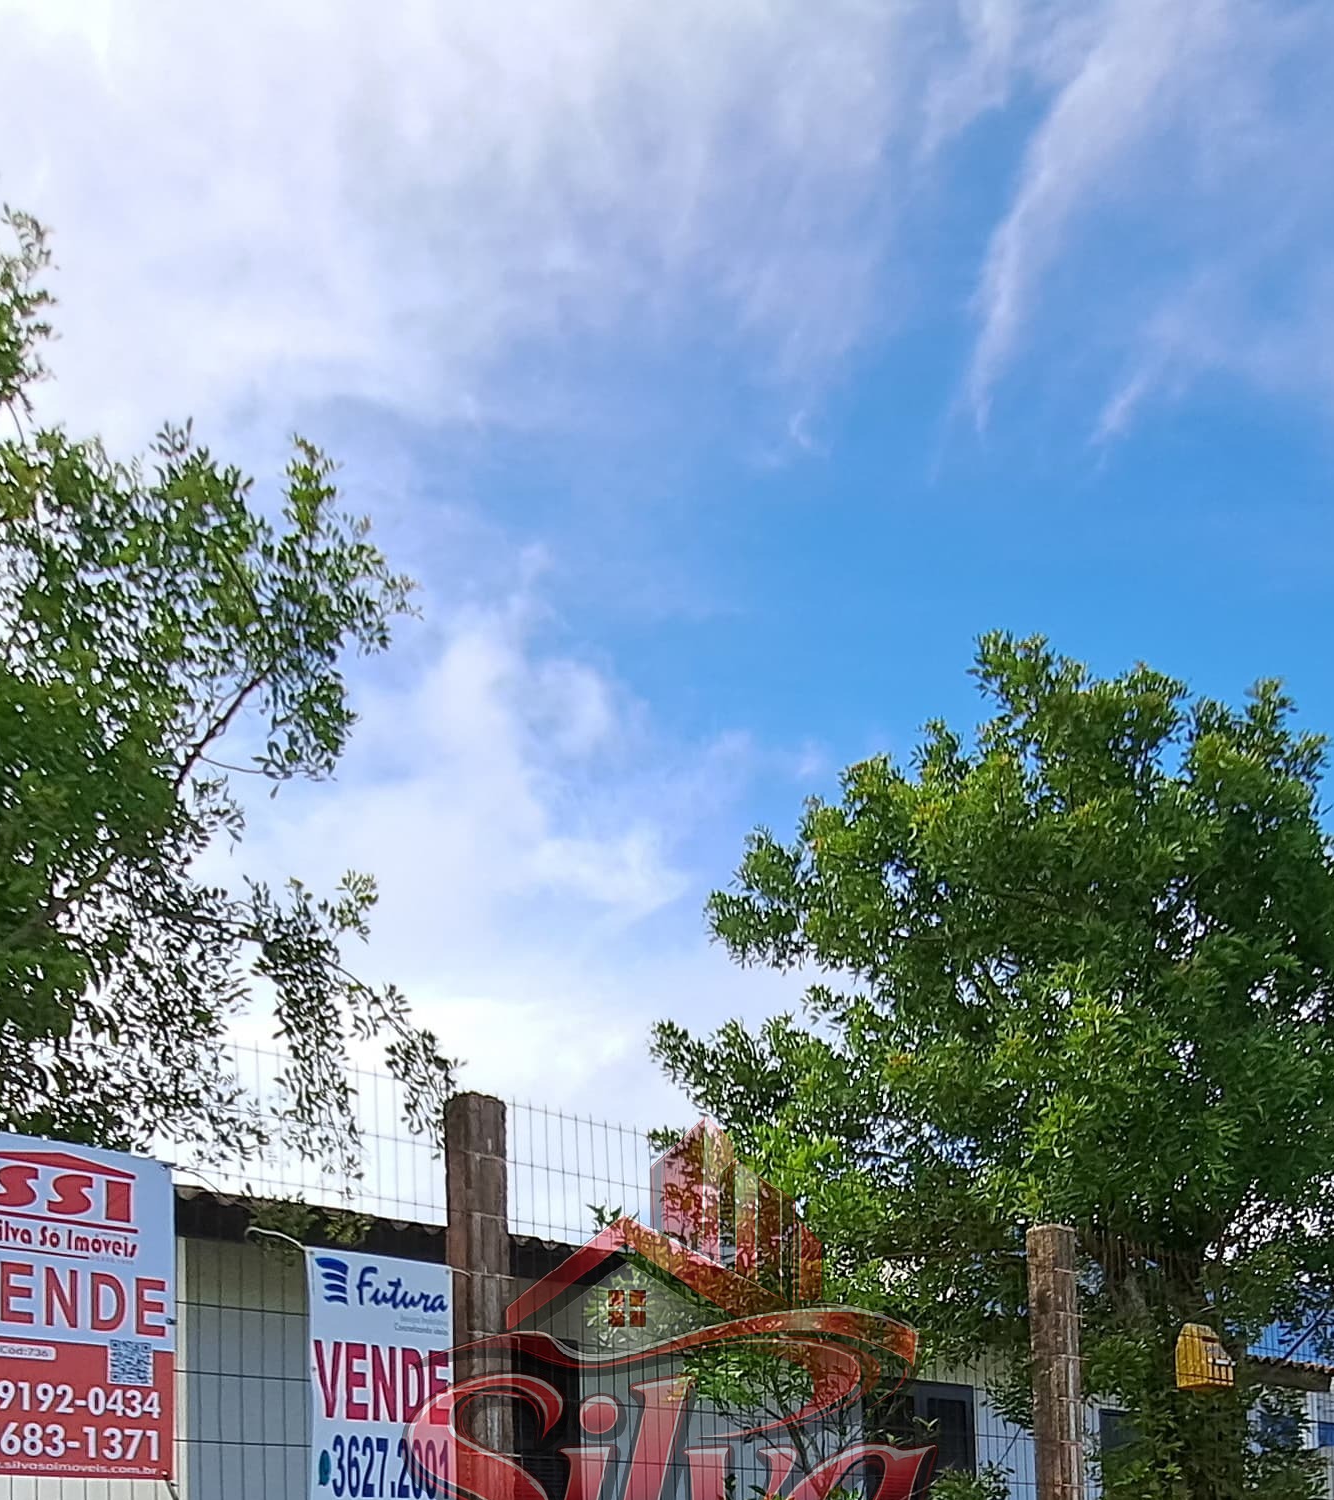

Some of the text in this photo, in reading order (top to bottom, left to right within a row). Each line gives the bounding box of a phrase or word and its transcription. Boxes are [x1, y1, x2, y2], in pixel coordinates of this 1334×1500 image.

[67, 1229, 138, 1258] Imóveis
[356, 1266, 448, 1313] Futura
[314, 1340, 450, 1425] VENDE
